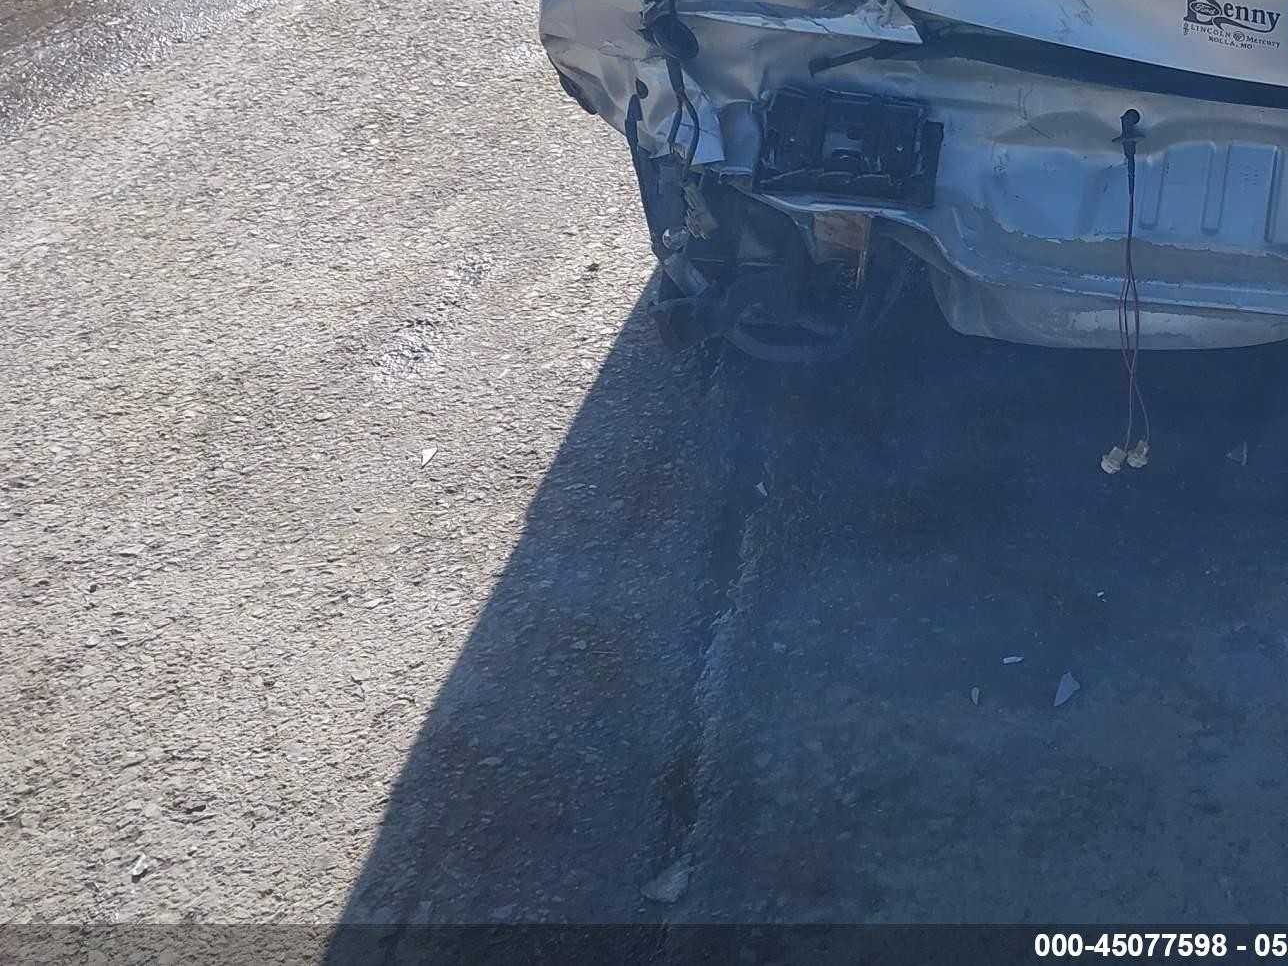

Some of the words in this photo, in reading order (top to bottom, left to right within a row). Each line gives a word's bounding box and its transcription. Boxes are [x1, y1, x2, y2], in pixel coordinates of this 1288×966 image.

[1190, 24, 1231, 39] LINCOLN
[1245, 35, 1281, 48] Mercury
[1240, 42, 1253, 50] MO
